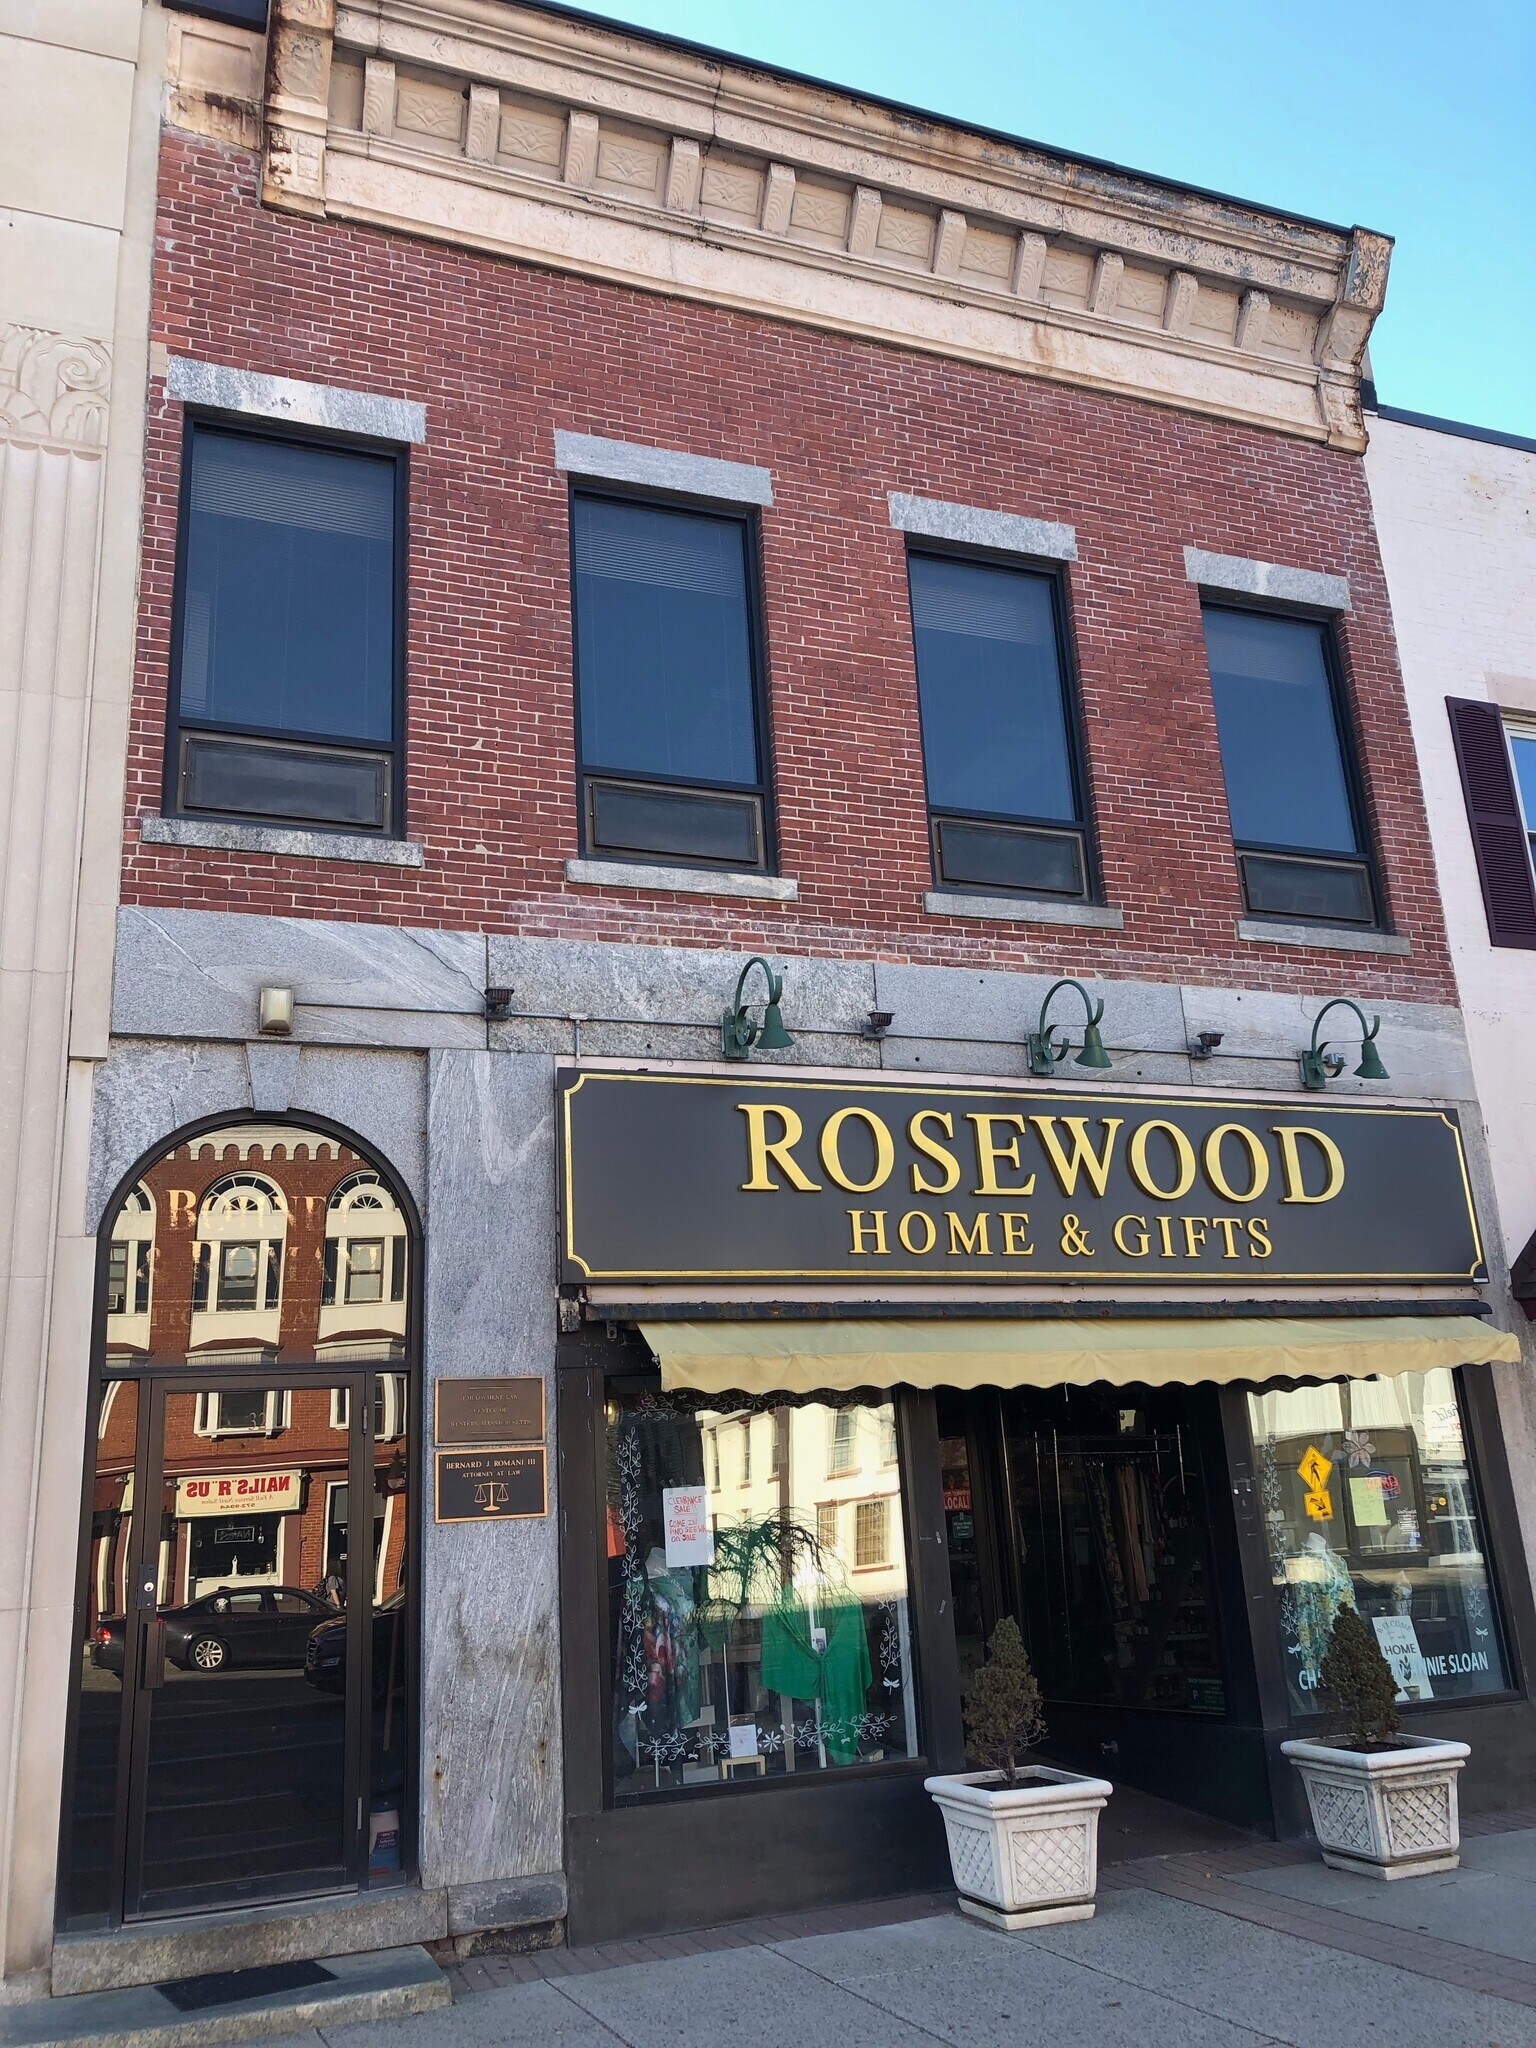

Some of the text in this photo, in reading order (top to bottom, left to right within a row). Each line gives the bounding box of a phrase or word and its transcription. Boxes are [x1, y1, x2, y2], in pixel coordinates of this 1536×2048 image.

[736, 1103, 1346, 1204] ROSEWOOD
[847, 1209, 1274, 1260] HOME & GIFTS
[446, 1461, 482, 1470] BERNARD
[493, 1459, 524, 1468] ROMANI
[461, 1471, 493, 1479] ATTORNEY
[668, 1496, 703, 1505] CLEARANCE
[669, 1518, 698, 1528] COME IN
[682, 1534, 696, 1542] SALE
[1383, 1643, 1417, 1656] HOME
[1448, 1651, 1489, 1675] SLOAN
